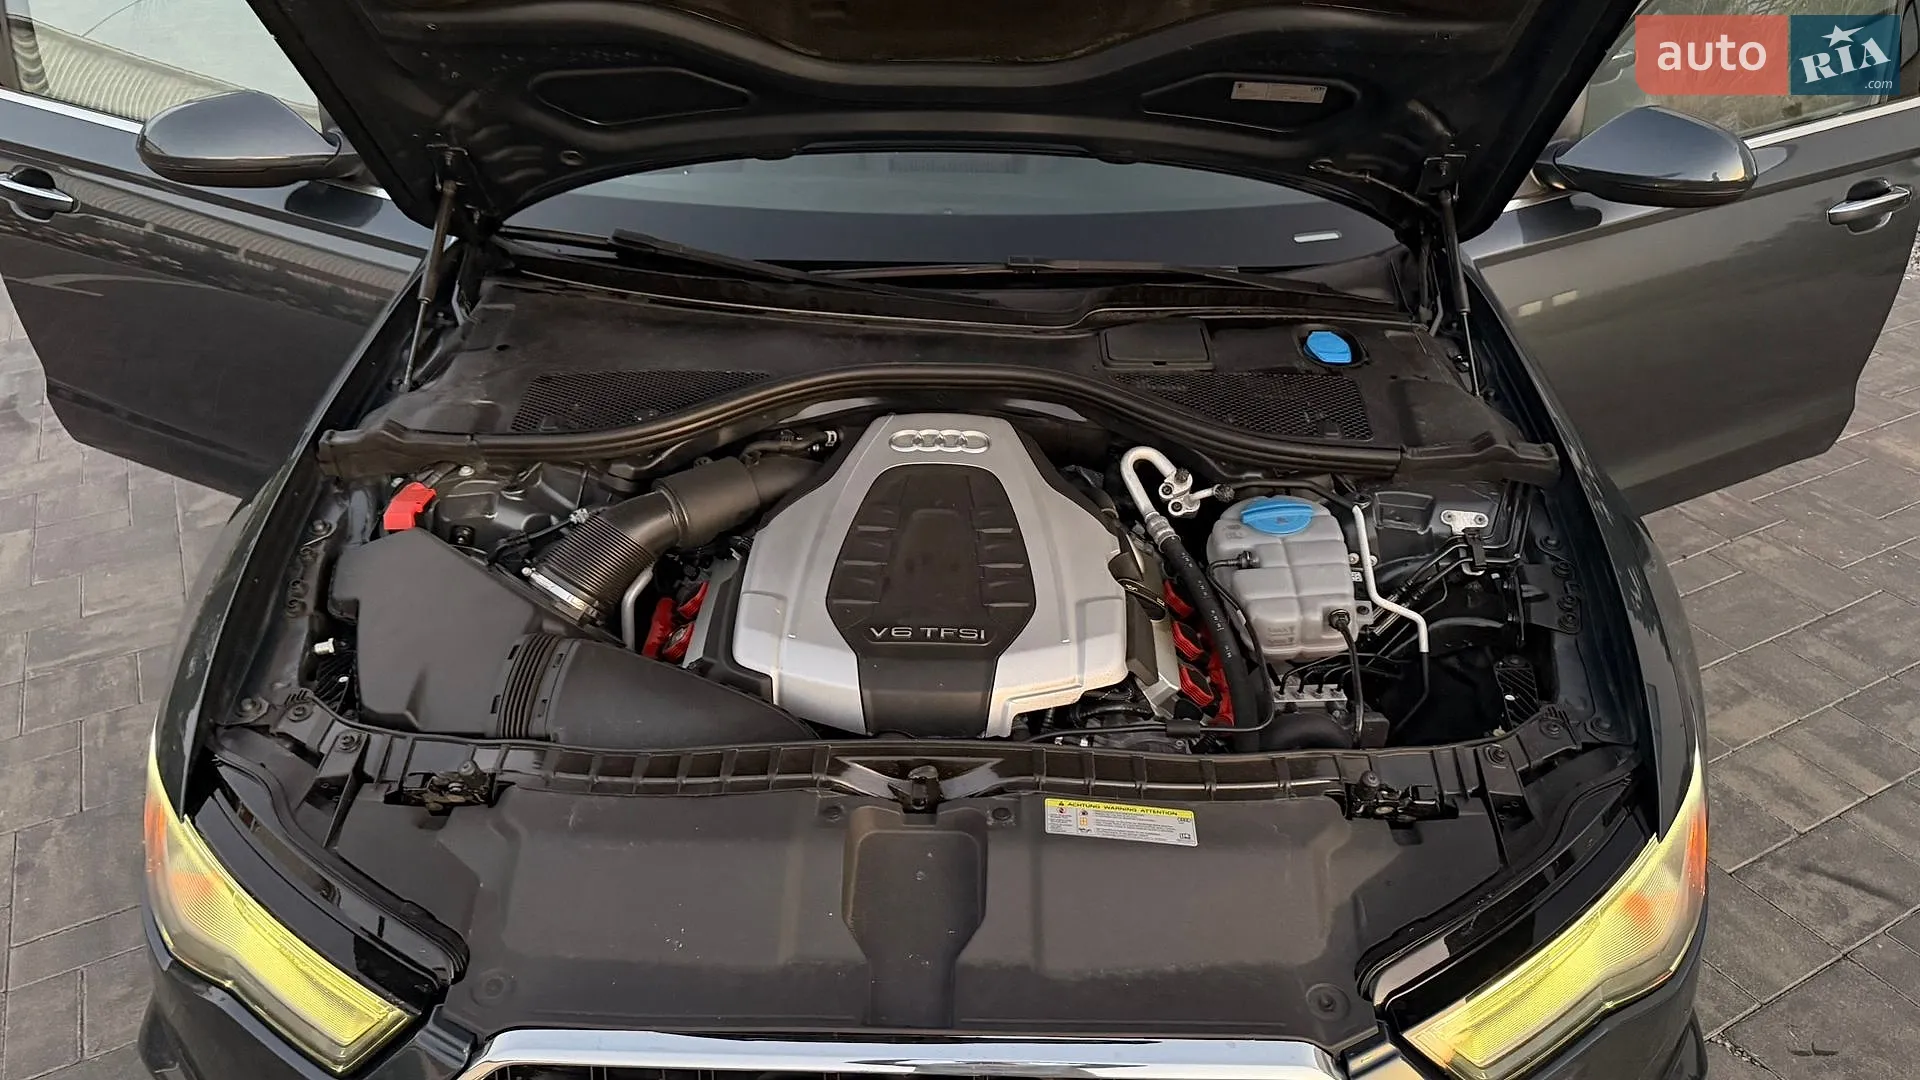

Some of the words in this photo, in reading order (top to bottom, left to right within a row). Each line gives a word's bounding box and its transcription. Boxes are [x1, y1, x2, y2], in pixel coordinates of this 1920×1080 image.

[870, 626, 912, 638] V6
[919, 627, 985, 640] TFSI
[1067, 801, 1101, 809] ACHTUNG
[1103, 804, 1137, 813] WARNING
[1140, 808, 1178, 816] ATTENTION
